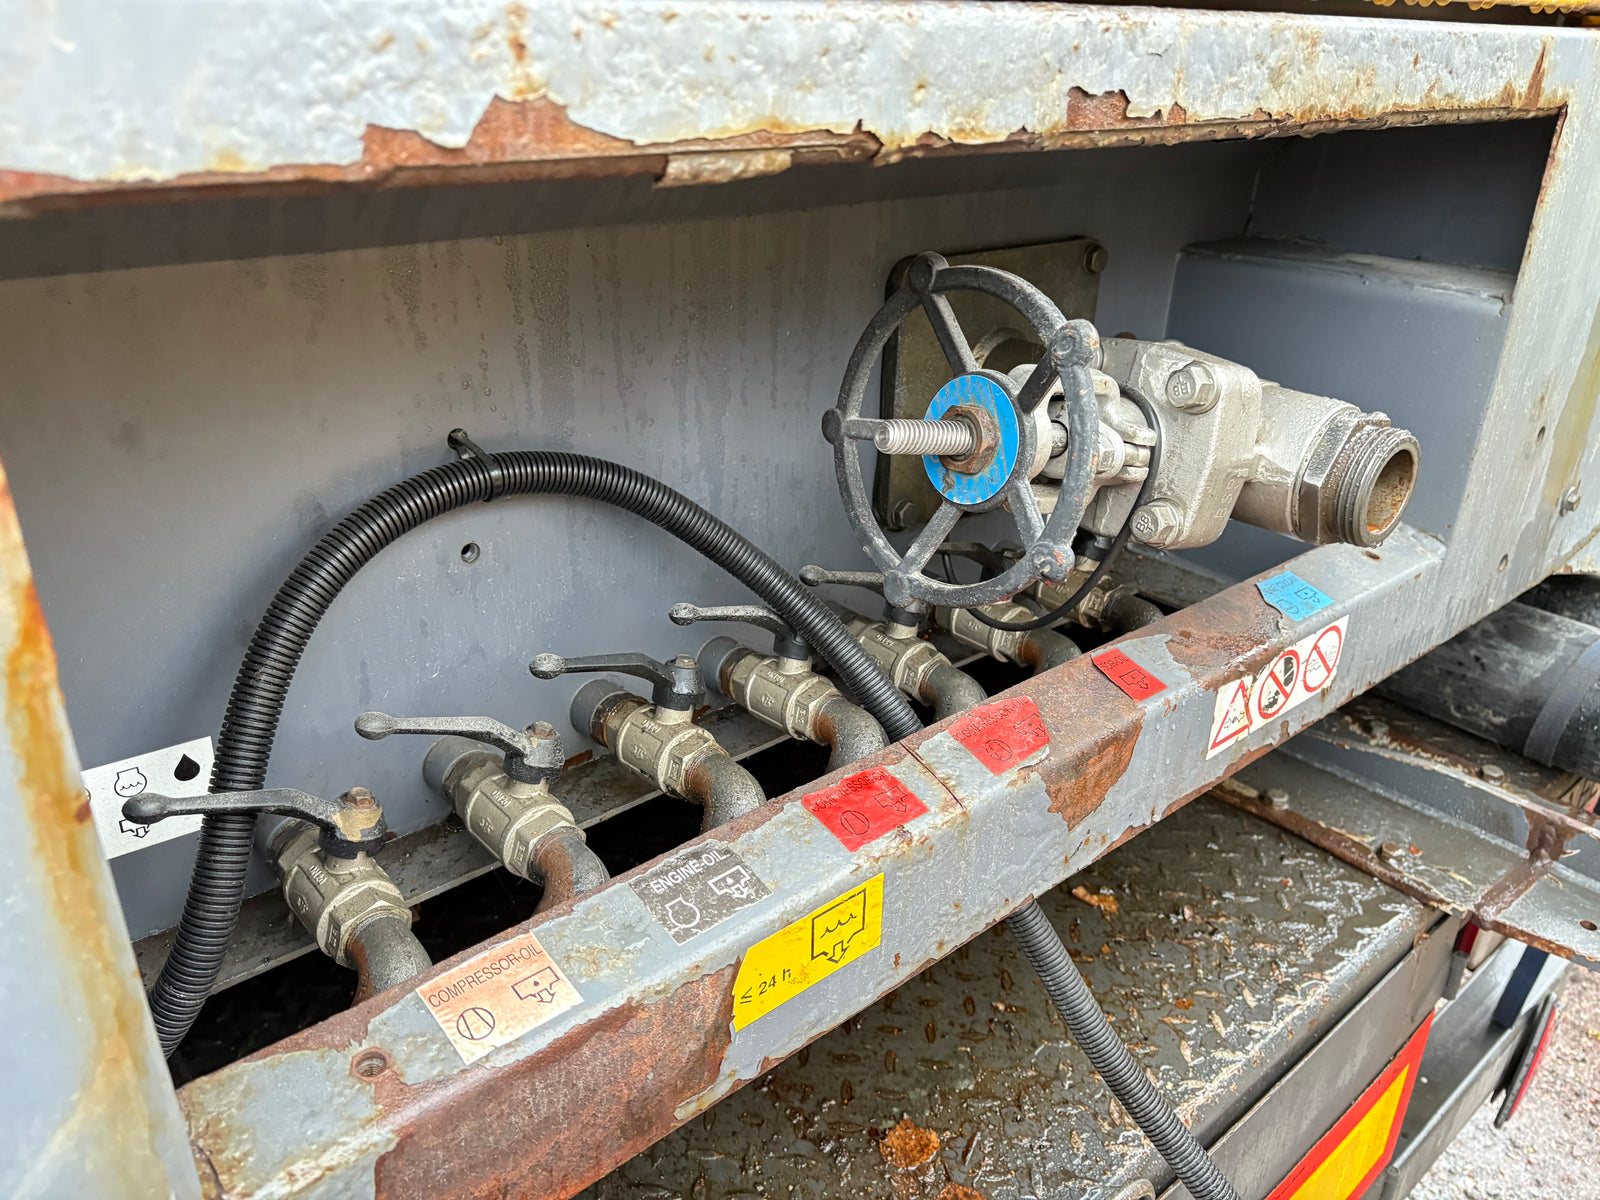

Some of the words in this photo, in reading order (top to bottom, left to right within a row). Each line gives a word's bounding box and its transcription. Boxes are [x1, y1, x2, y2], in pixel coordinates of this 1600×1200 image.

[1097, 655, 1130, 671] SOR-OIL
[650, 849, 730, 894] ENGINE-OIL
[428, 943, 543, 1008] COMPRESSOR-OIL
[758, 974, 777, 997] 24
